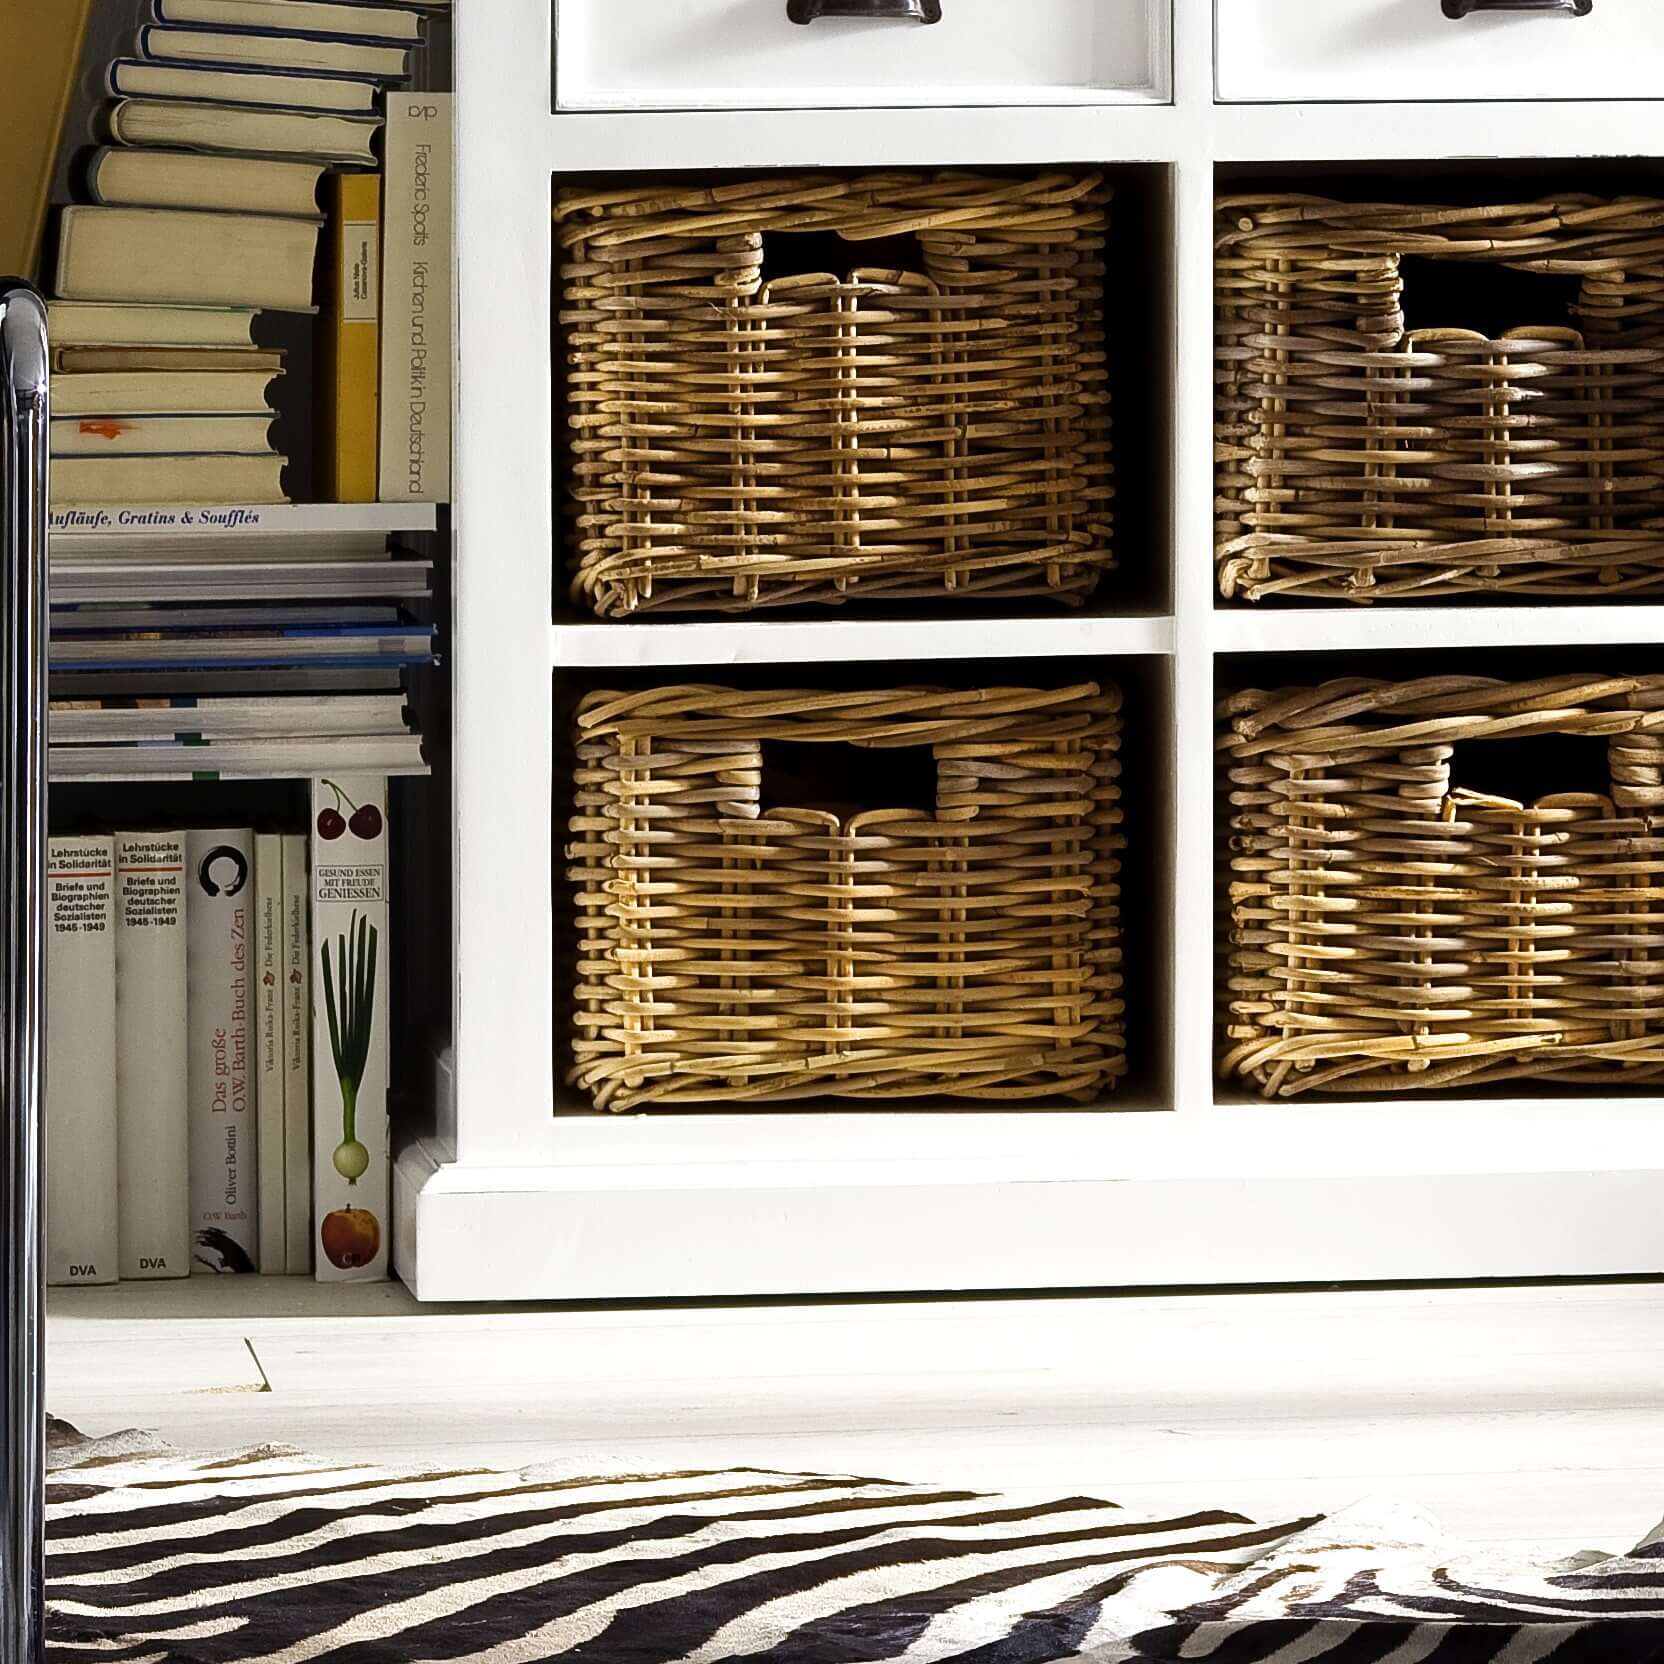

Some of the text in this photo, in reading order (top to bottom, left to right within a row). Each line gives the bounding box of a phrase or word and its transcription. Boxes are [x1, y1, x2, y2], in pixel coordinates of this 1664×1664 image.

[119, 511, 175, 525] Gratins
[181, 511, 193, 524] &
[199, 510, 259, 528] Soufflés
[123, 842, 178, 852] Lehrstücke
[130, 854, 182, 864] Solidarität
[319, 869, 380, 878] GESUND ESSEN
[127, 877, 176, 885] Briefe und
[341, 878, 374, 887] FREUDE
[123, 887, 180, 896] Biographien
[319, 887, 380, 899] GENIESSEN
[128, 897, 176, 905] deutscher
[125, 907, 177, 915] Sozialisten
[232, 908, 245, 943] Zen
[232, 947, 245, 976] des
[232, 979, 245, 1080] Barth-Buch
[213, 1029, 227, 1113] Das große
[226, 1166, 236, 1204] Oliver
[69, 1265, 96, 1277] DVA
